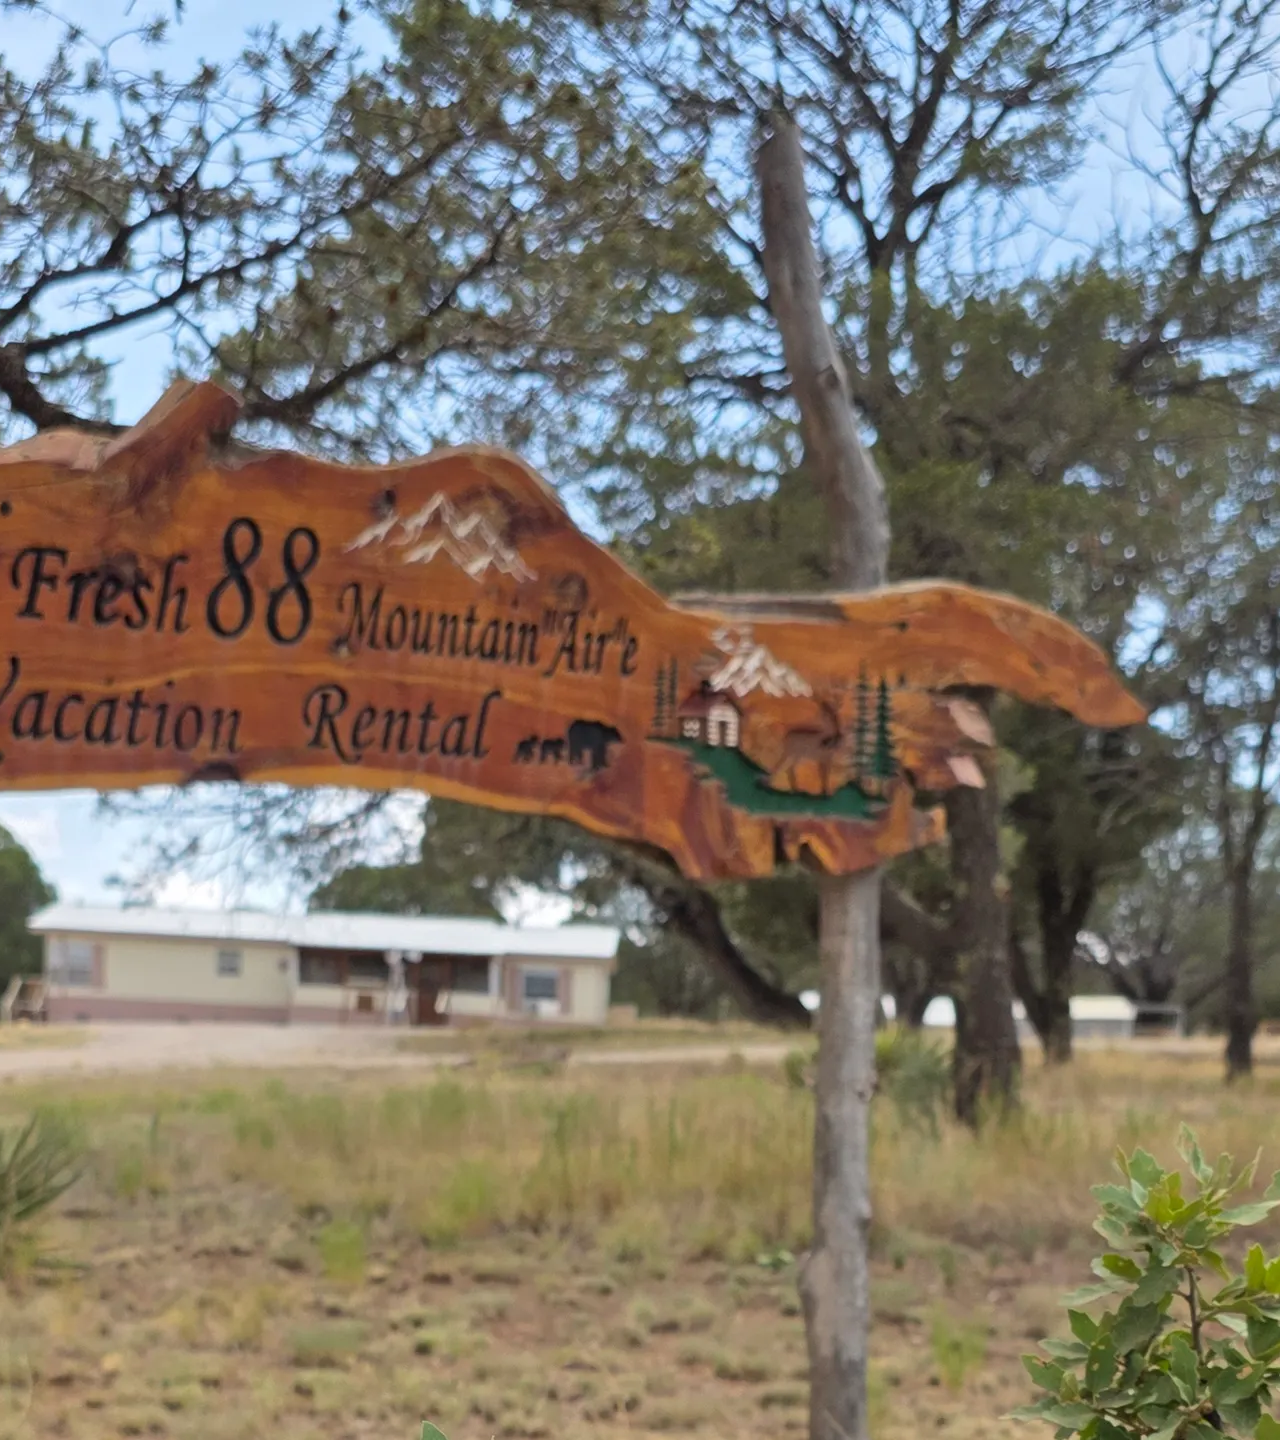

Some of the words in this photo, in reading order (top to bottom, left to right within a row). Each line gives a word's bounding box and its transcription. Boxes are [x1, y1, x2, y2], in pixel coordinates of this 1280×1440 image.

[11, 546, 191, 634] Fresh
[206, 516, 321, 645] 88
[333, 580, 539, 666] Mountain
[302, 684, 502, 765] Rental
